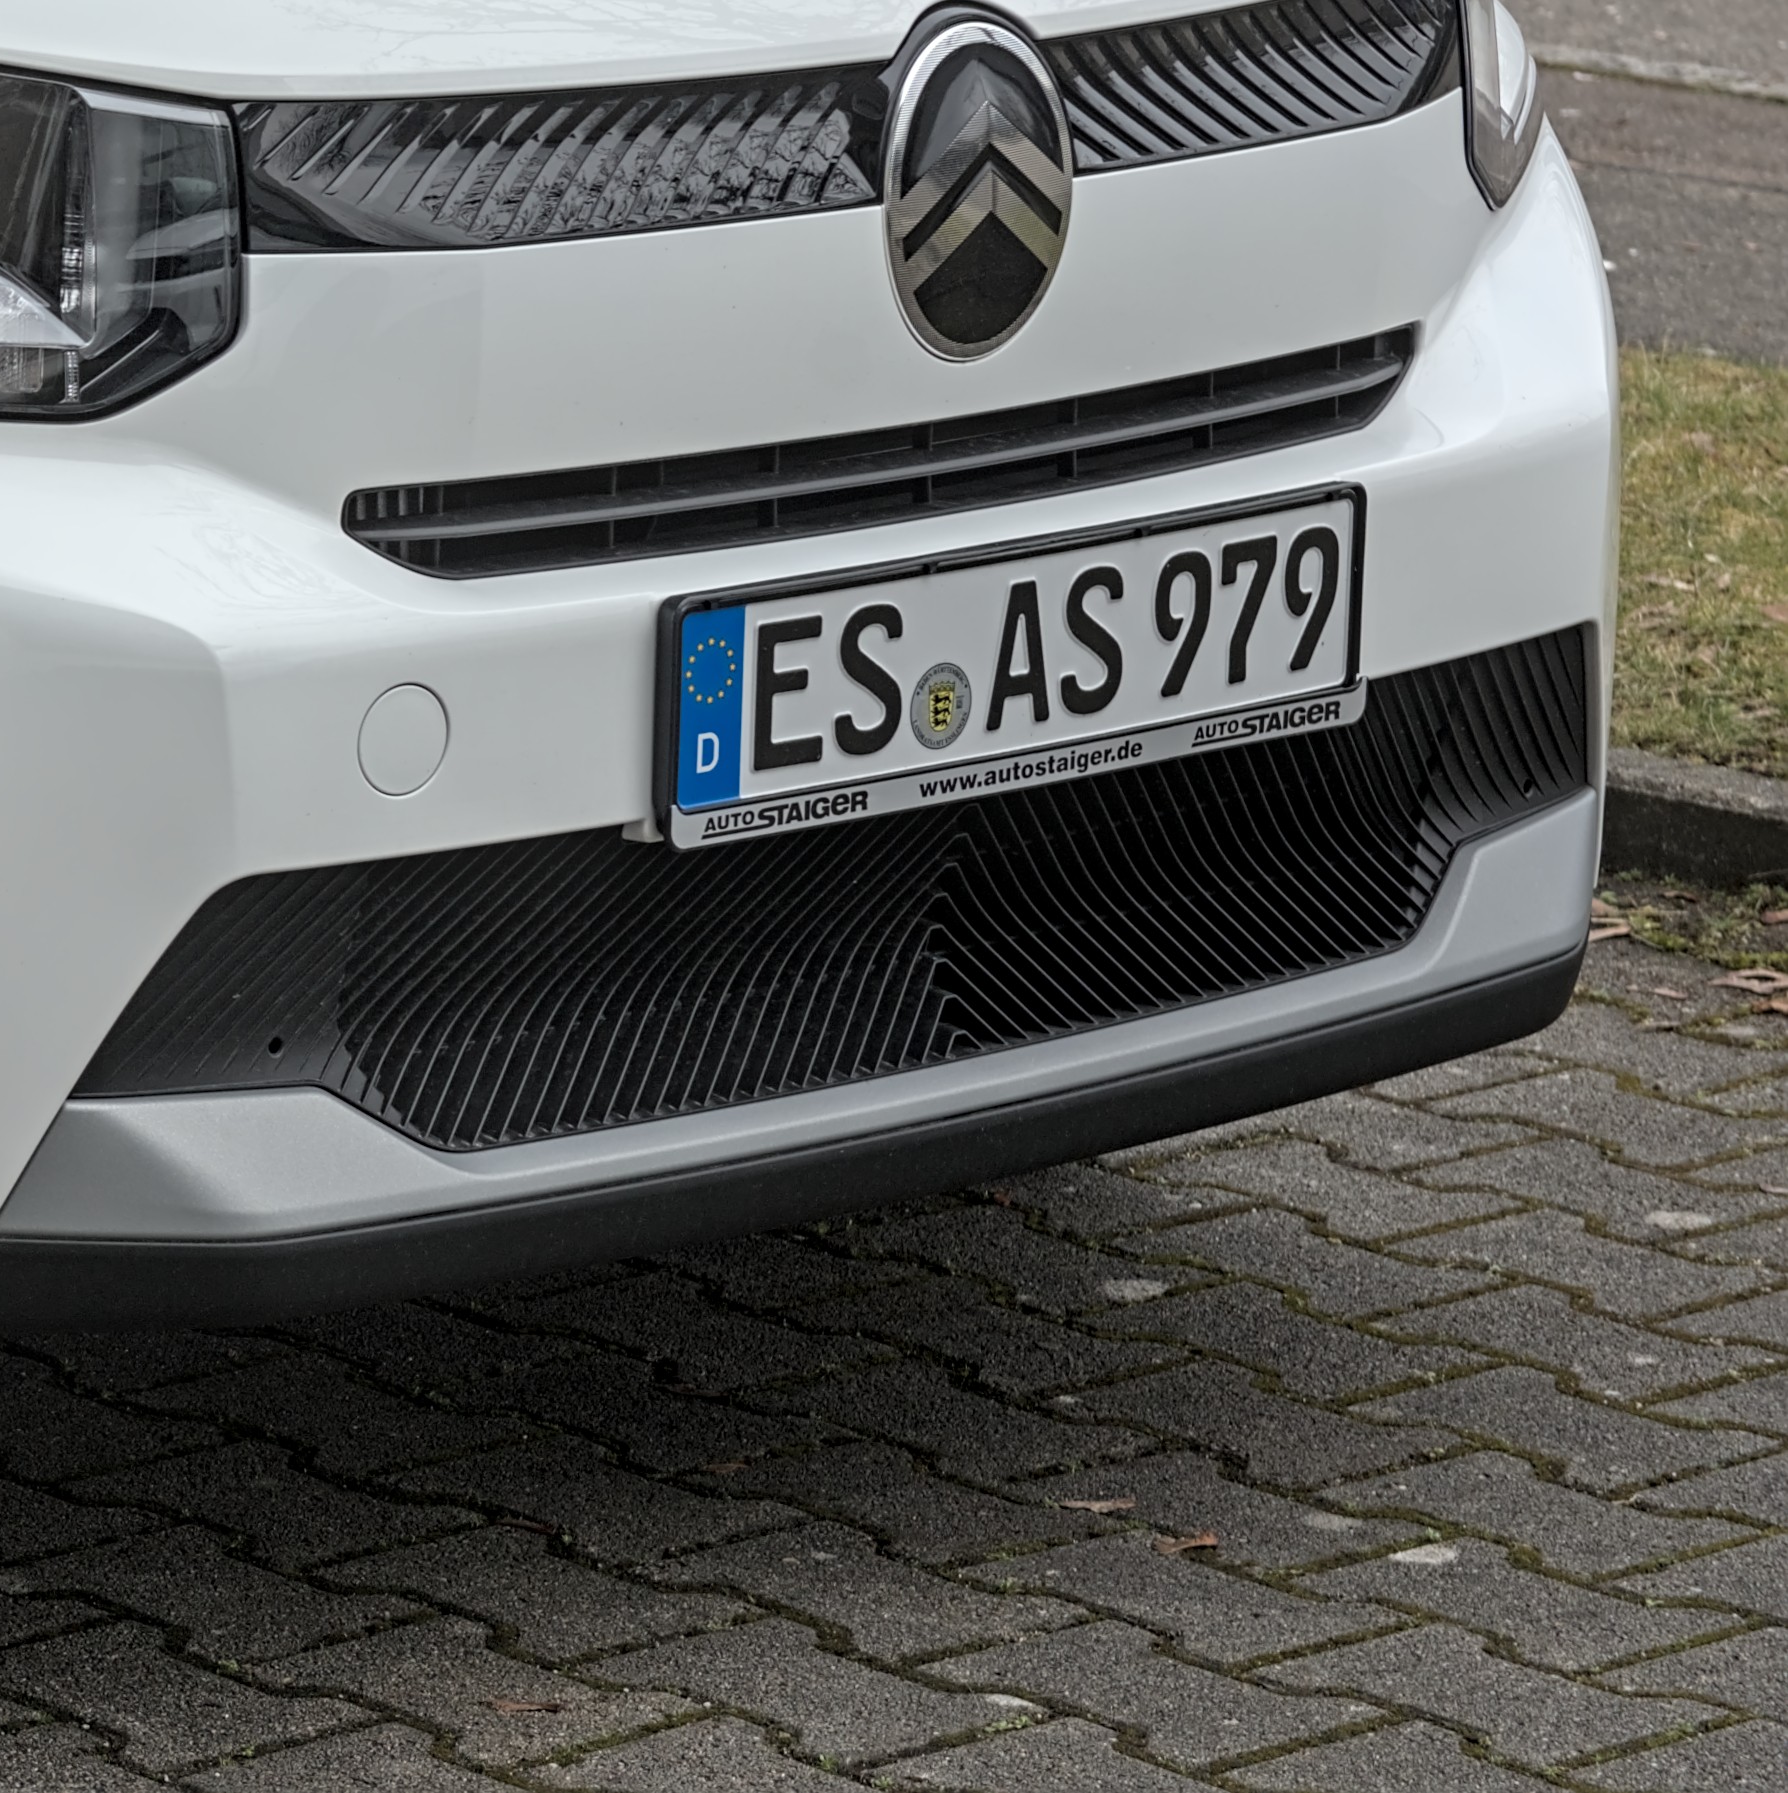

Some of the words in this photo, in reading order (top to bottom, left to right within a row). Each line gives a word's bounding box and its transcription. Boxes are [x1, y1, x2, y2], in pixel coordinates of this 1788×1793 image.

[753, 603, 903, 771] ES
[986, 565, 1124, 732] AS
[1154, 525, 1340, 698] 979
[1193, 719, 1239, 742] AUTO
[696, 731, 721, 774] D
[919, 740, 1143, 798] www.autostaiger.de
[704, 810, 755, 833] AUTO
